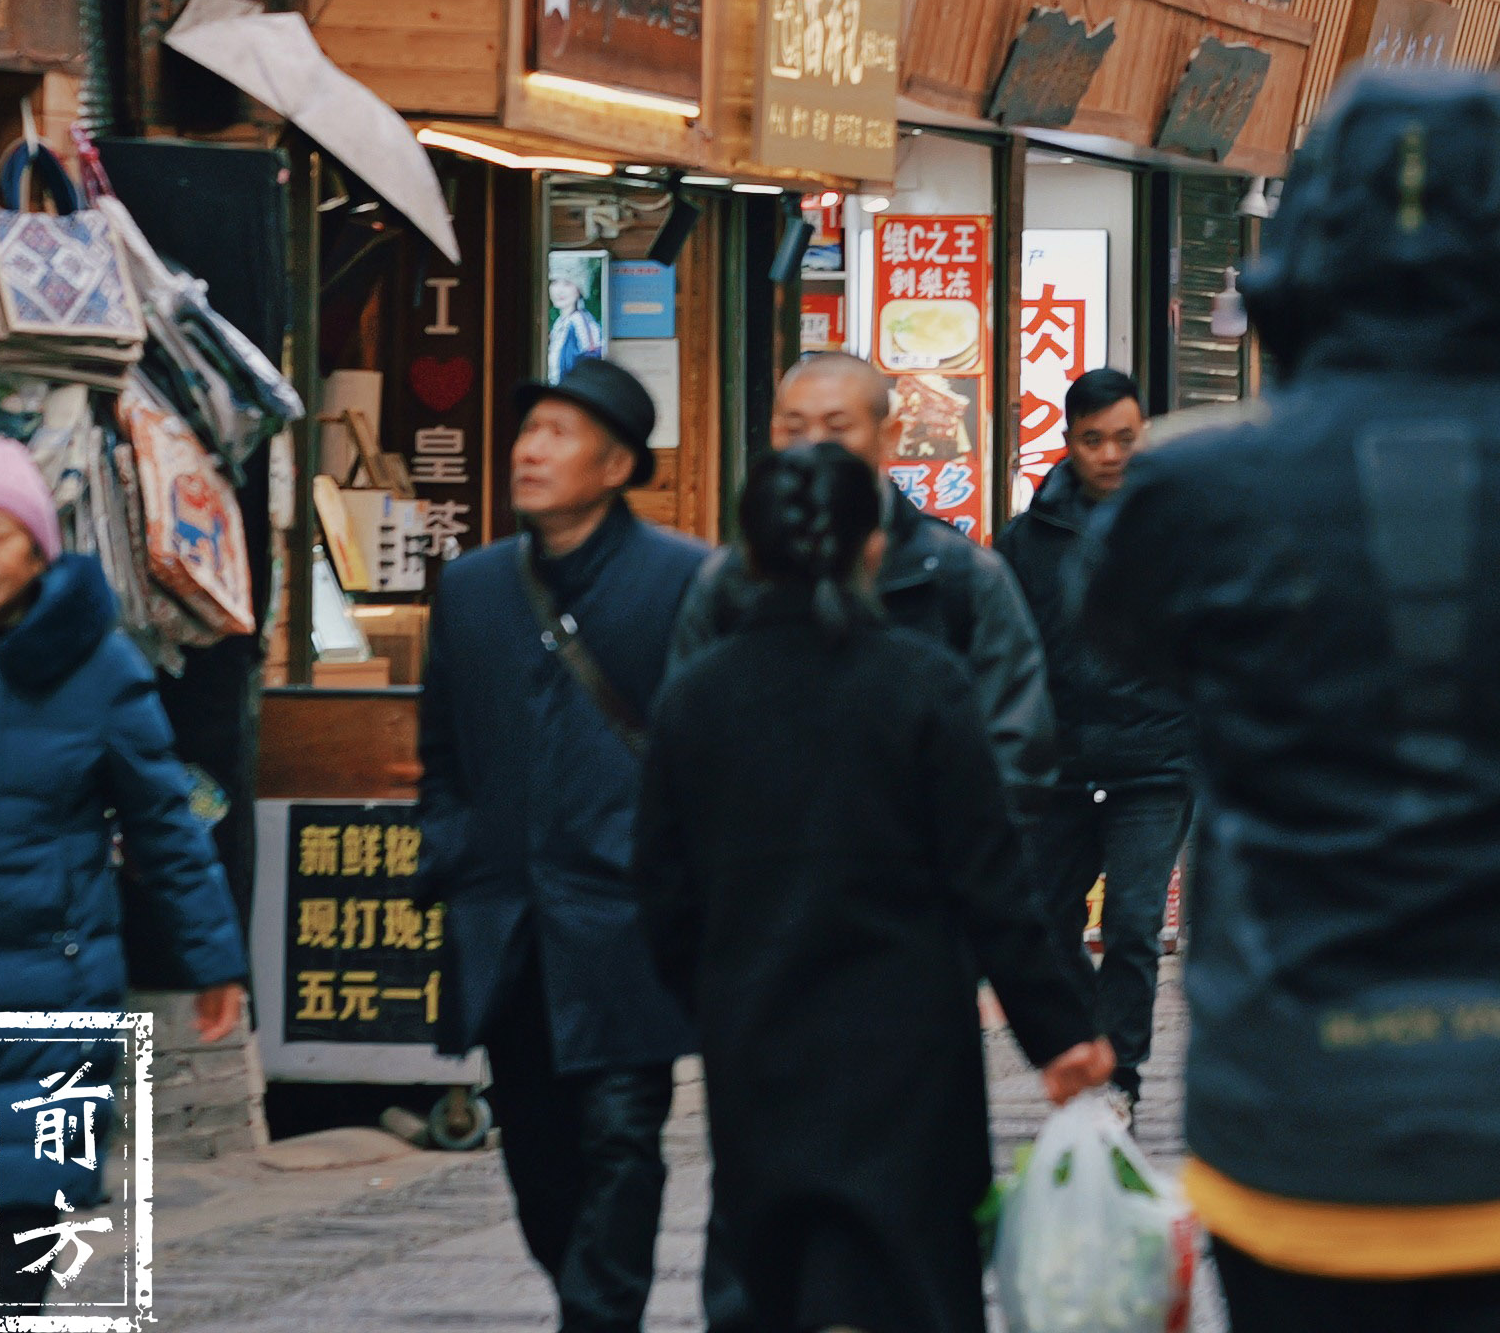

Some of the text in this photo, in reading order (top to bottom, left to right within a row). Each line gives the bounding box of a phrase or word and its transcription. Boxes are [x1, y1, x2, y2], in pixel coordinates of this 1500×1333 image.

[881, 221, 978, 265] 维C之王
[424, 277, 460, 334] I
